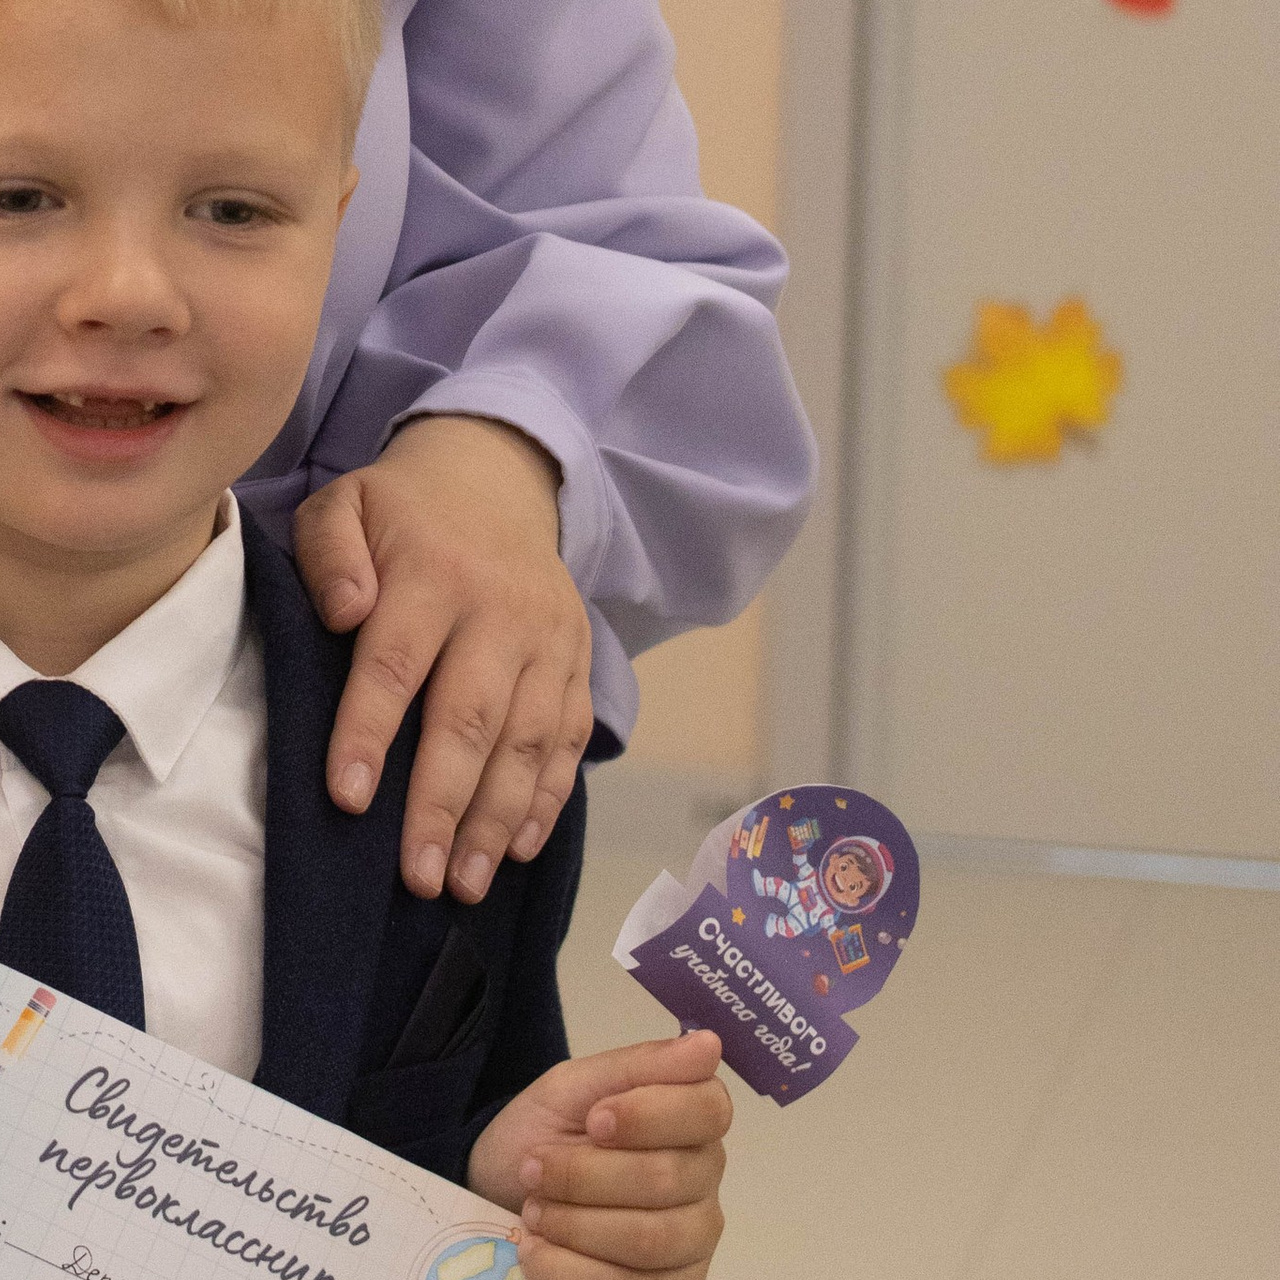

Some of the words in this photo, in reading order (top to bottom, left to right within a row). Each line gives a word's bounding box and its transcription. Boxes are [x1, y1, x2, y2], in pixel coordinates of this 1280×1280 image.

[669, 943, 757, 1022] учебного
[754, 1024, 812, 1074] года!
[698, 916, 827, 1056] Счастливого
[64, 1065, 371, 1246] Свидетельство
